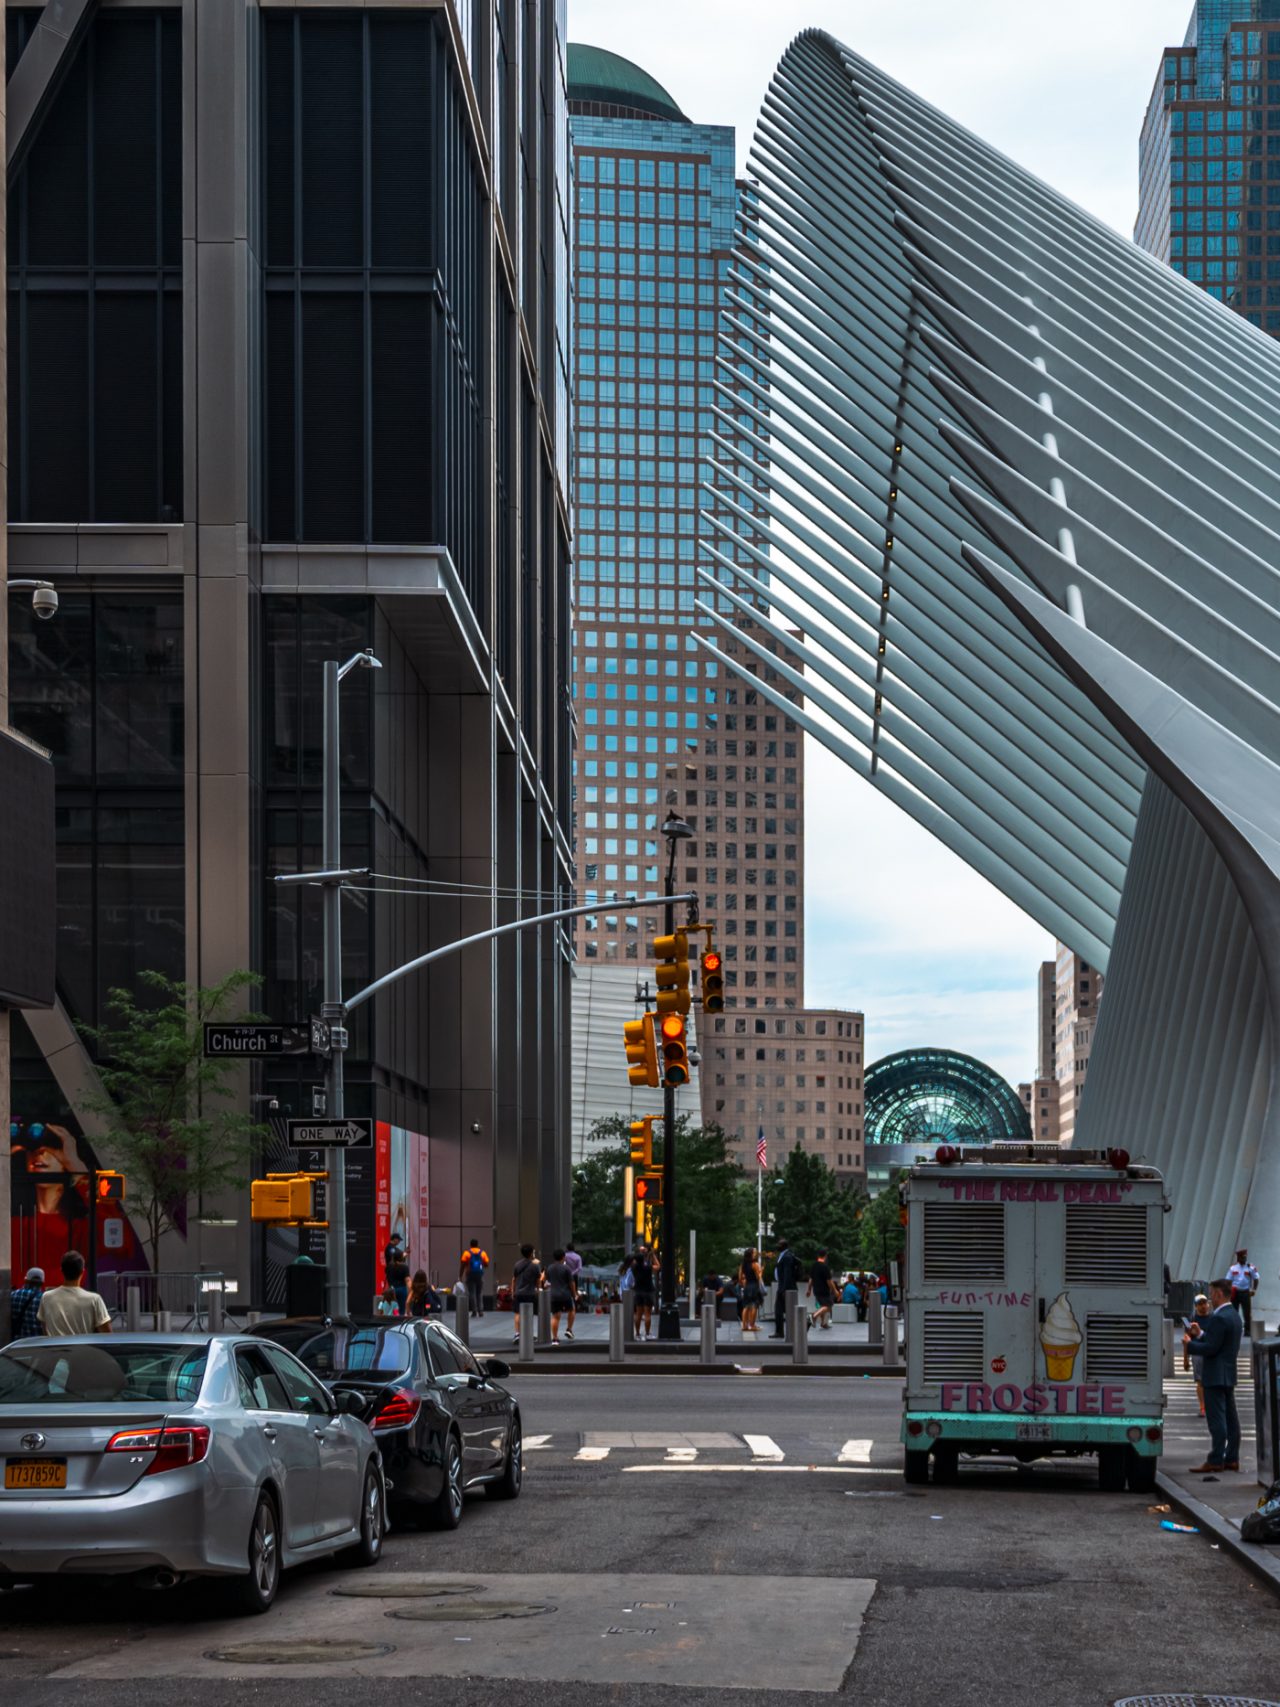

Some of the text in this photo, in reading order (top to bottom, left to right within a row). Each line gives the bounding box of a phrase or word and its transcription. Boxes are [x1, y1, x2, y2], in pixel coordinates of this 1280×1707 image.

[212, 1033, 278, 1050] Church St
[300, 1128, 360, 1140] ONE WAY
[1000, 1181, 1058, 1201] REAL
[991, 1361, 1007, 1369] NYC
[941, 1382, 1126, 1414] FROSTEE
[10, 1466, 61, 1482] T737859C
